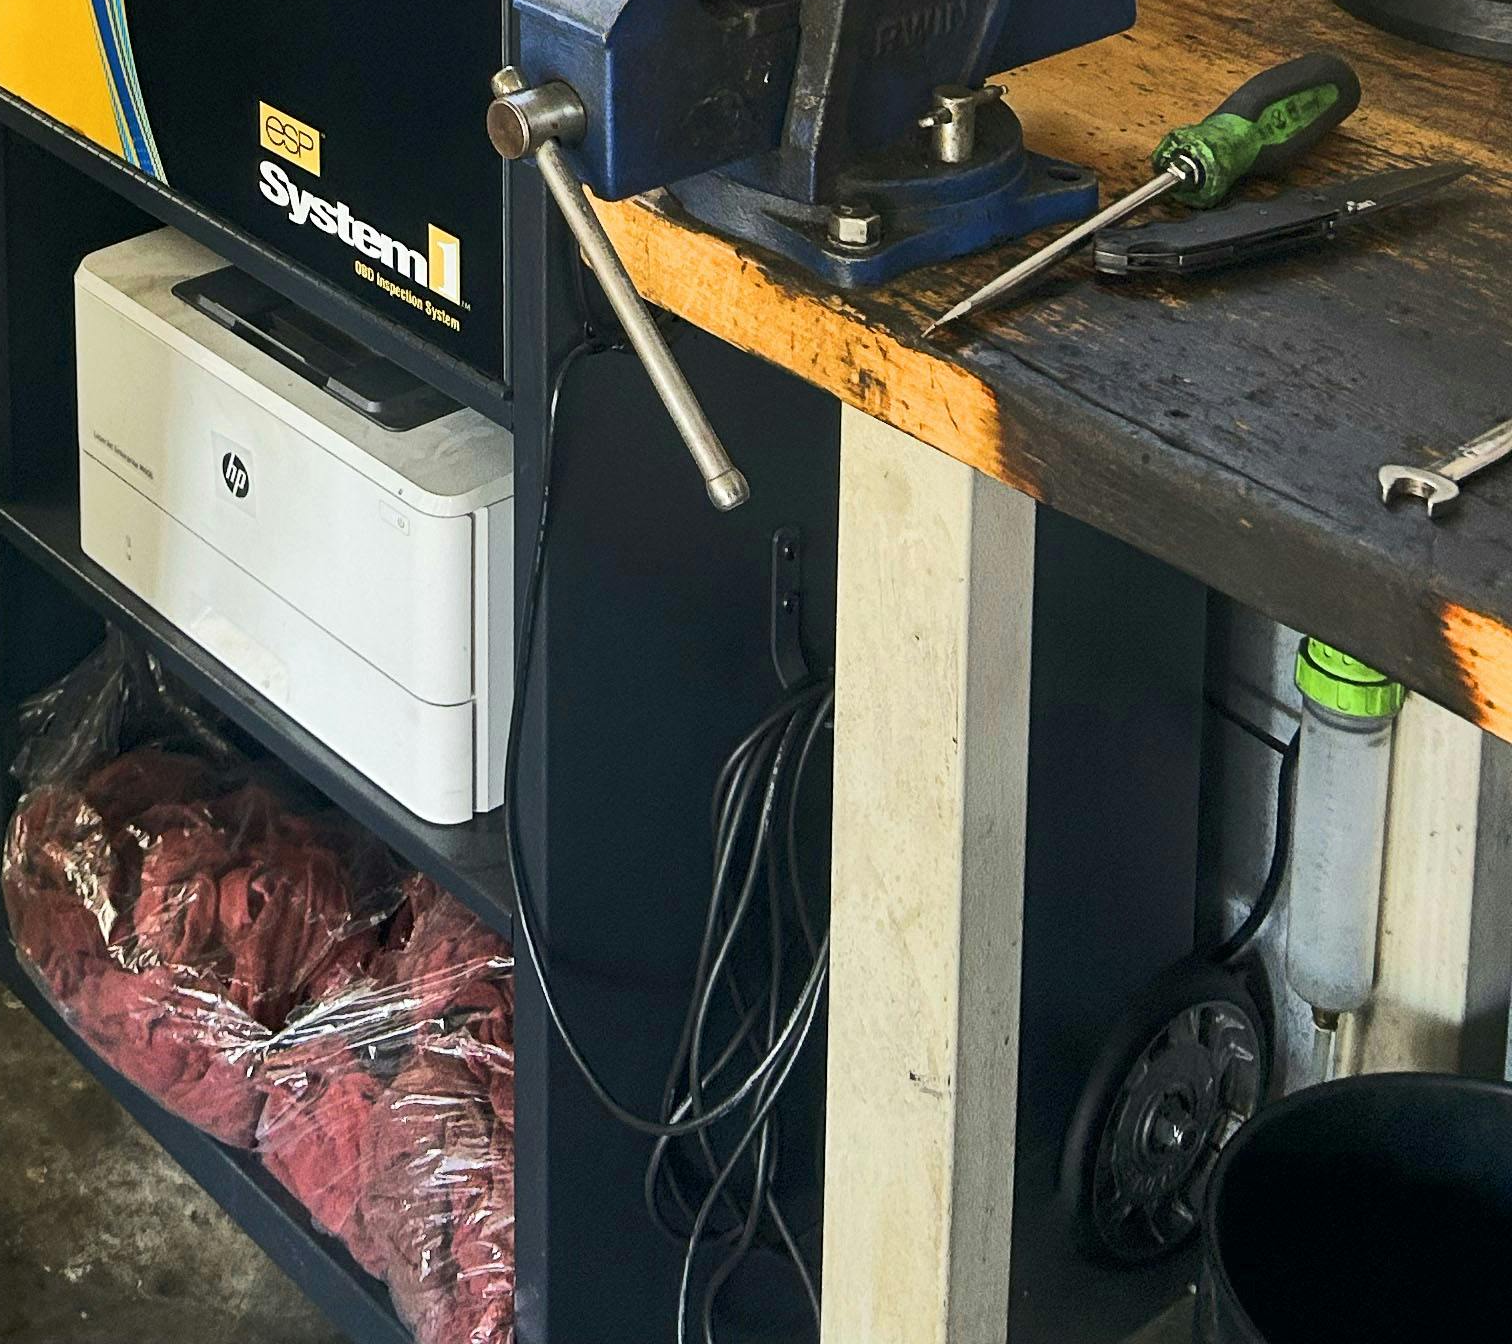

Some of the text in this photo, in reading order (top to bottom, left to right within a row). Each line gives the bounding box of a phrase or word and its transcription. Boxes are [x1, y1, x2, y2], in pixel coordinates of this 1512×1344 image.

[354, 260, 461, 332] OBD Inspection System
